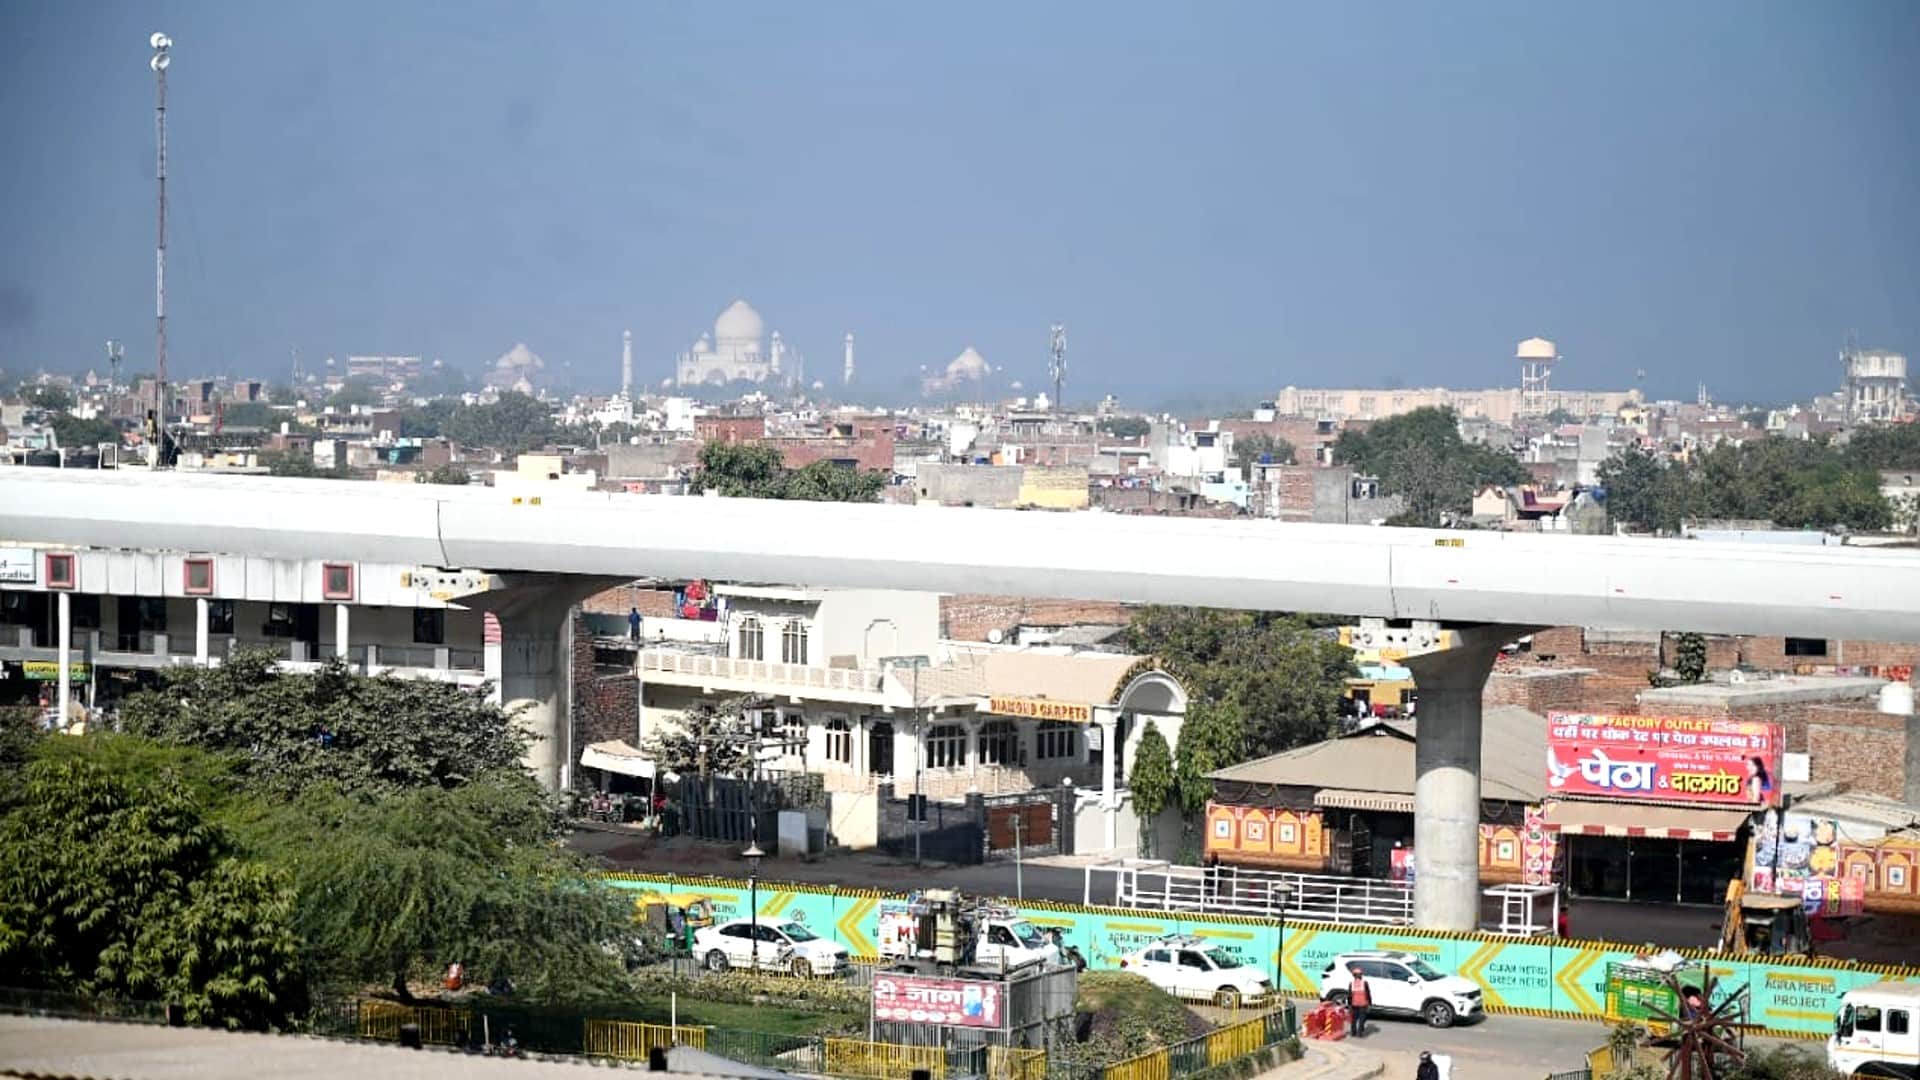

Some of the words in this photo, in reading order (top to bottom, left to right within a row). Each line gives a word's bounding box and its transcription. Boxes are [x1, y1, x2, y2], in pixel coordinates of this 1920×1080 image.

[991, 698, 1037, 716] DIAMOND
[1040, 703, 1088, 720] CARPETS
[1608, 716, 1663, 730] FACTORY
[1665, 719, 1711, 732] OUTLET
[1578, 749, 1657, 792] पेठा
[1658, 775, 1669, 789] &
[1671, 768, 1741, 796] दालमोठ
[1489, 962, 1517, 973] CLEAN
[1765, 979, 1797, 992] AGRA
[1798, 982, 1837, 994] METRO
[1774, 994, 1827, 1009] PROJECT
